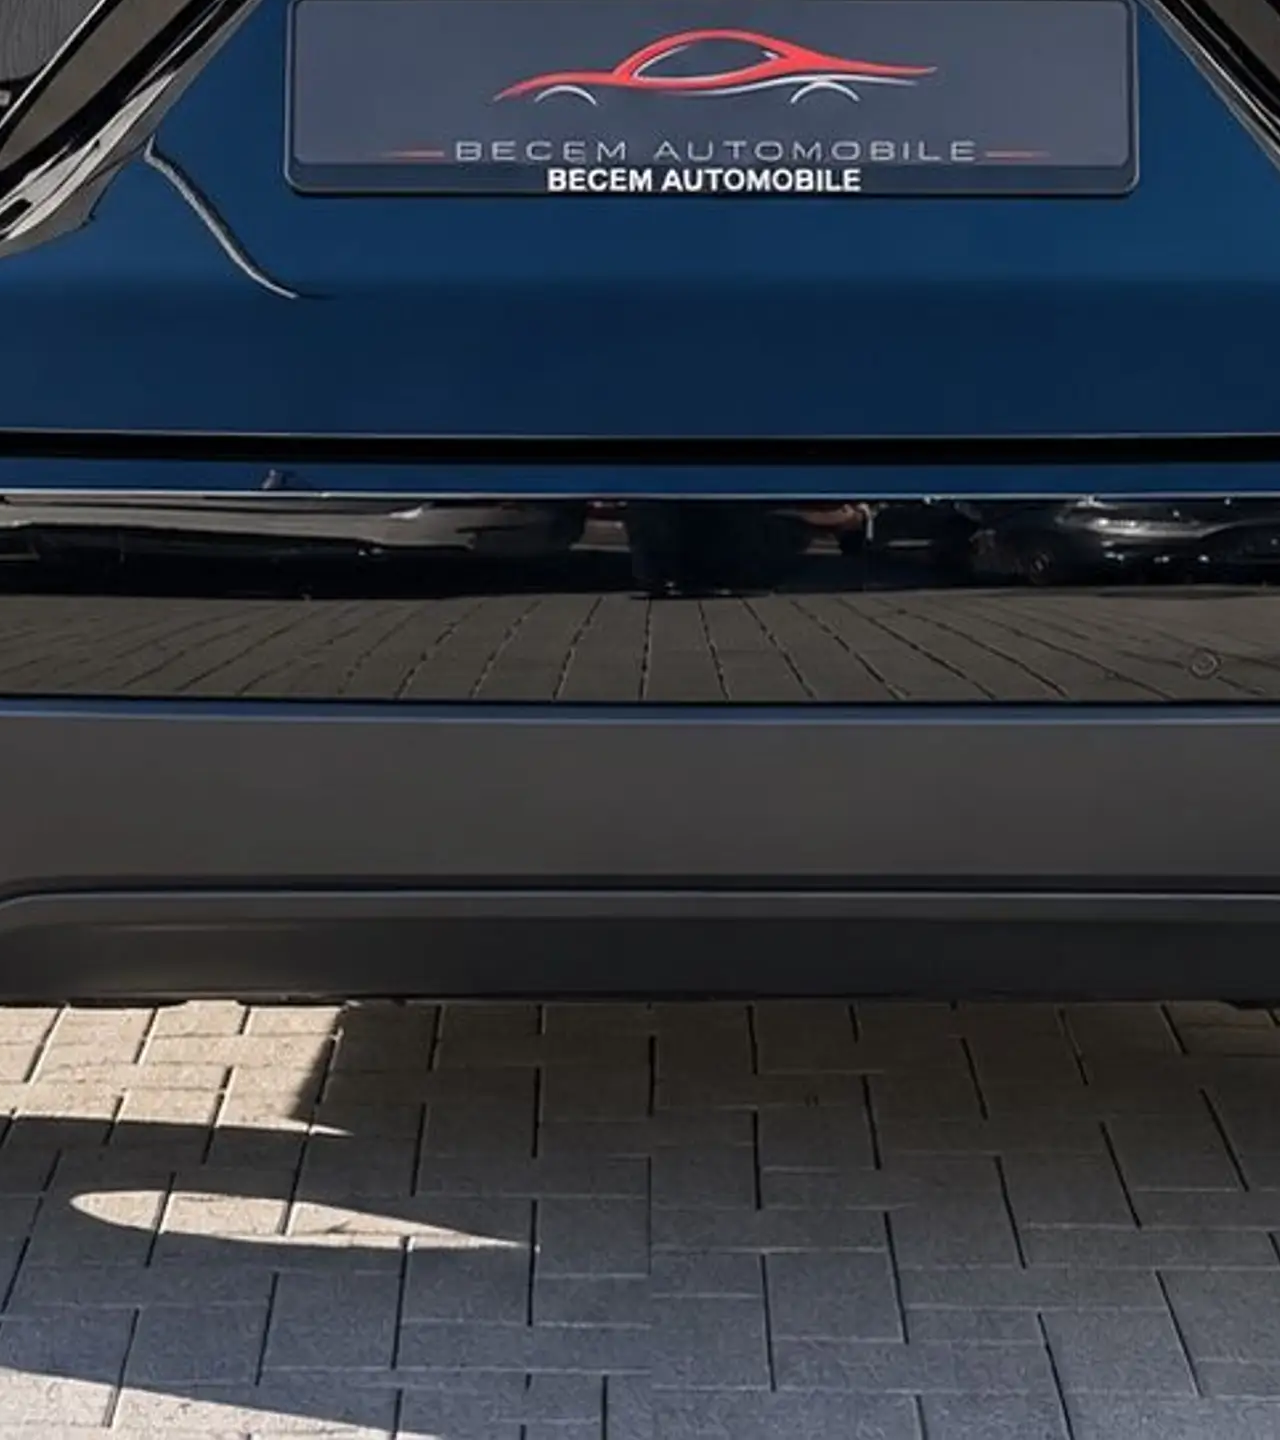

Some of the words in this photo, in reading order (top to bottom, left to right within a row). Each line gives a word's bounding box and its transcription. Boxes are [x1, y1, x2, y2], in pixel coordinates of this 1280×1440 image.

[455, 140, 627, 163] BECEM
[653, 140, 976, 163] AUTOMOBILE
[547, 168, 653, 192] BECEM
[661, 168, 861, 192] AUTOMOBILE
